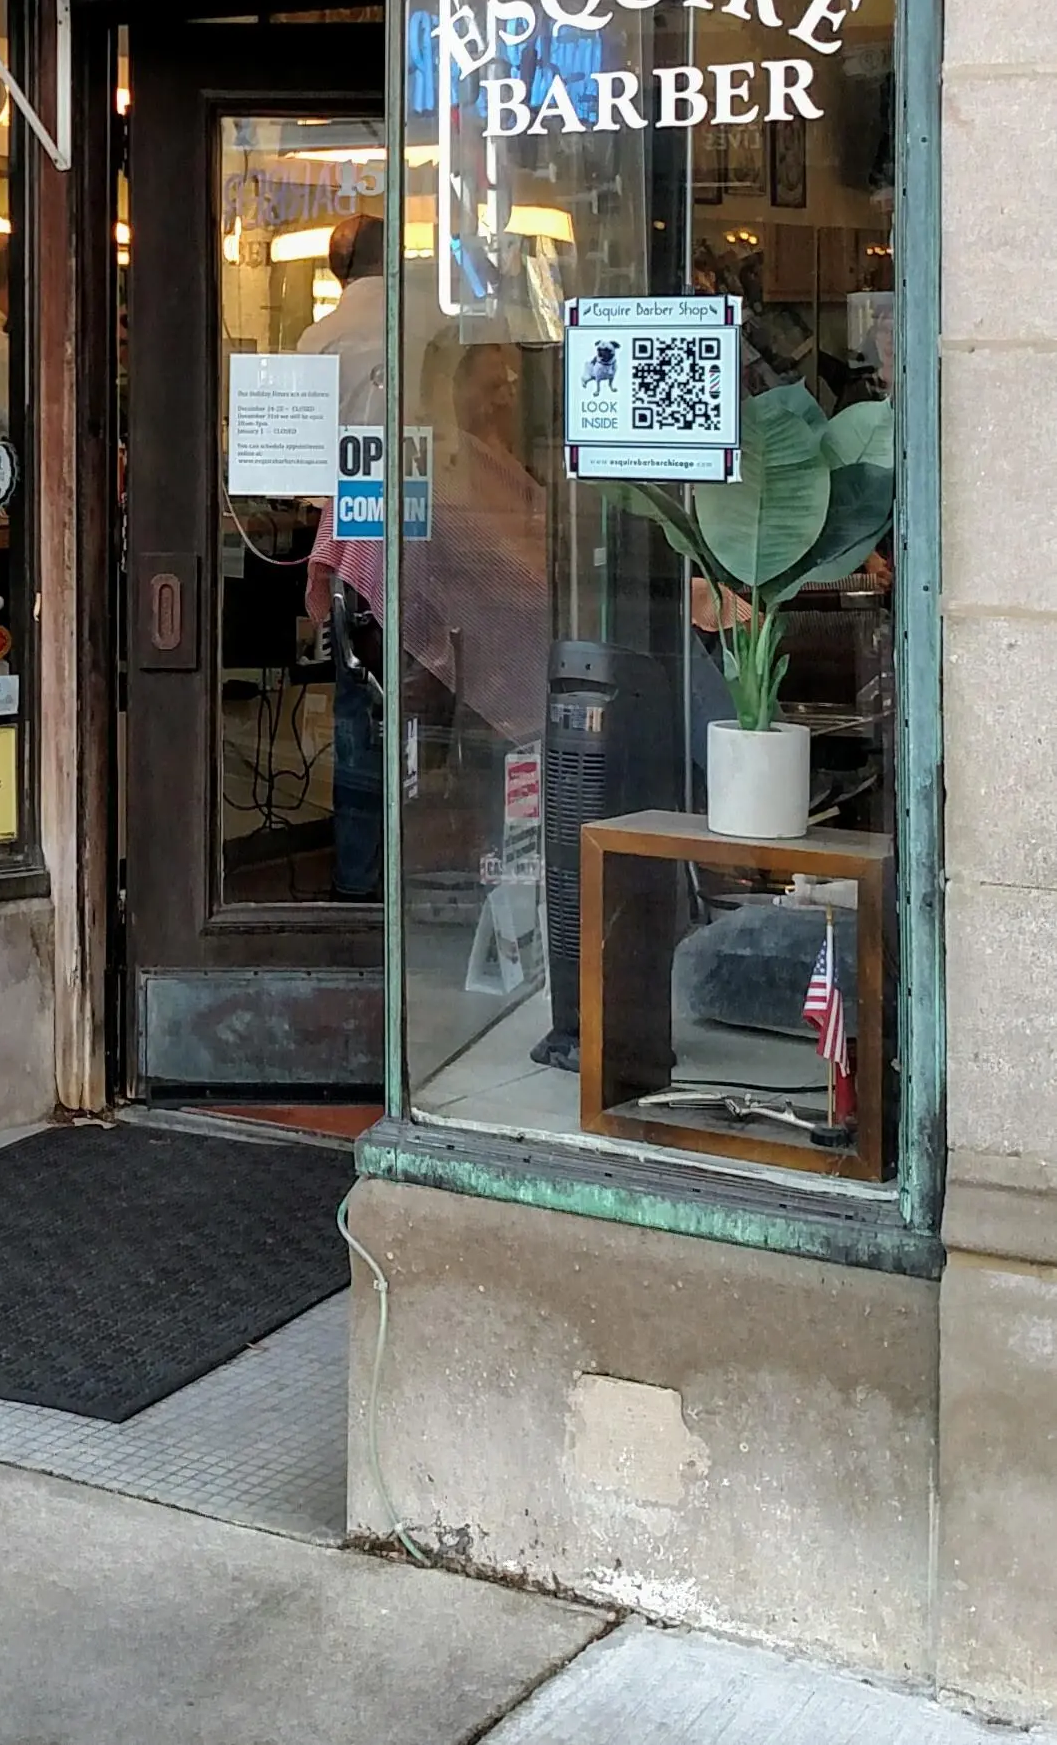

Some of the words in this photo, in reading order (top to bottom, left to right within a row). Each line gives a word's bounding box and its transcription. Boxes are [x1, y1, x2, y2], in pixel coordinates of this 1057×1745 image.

[480, 58, 824, 137] BARBER
[637, 302, 673, 316] Barber
[679, 302, 709, 321] Shop
[582, 401, 617, 413] LOOK
[582, 417, 618, 429] INSIDE
[339, 435, 428, 477] OPN
[404, 497, 425, 522] IN
